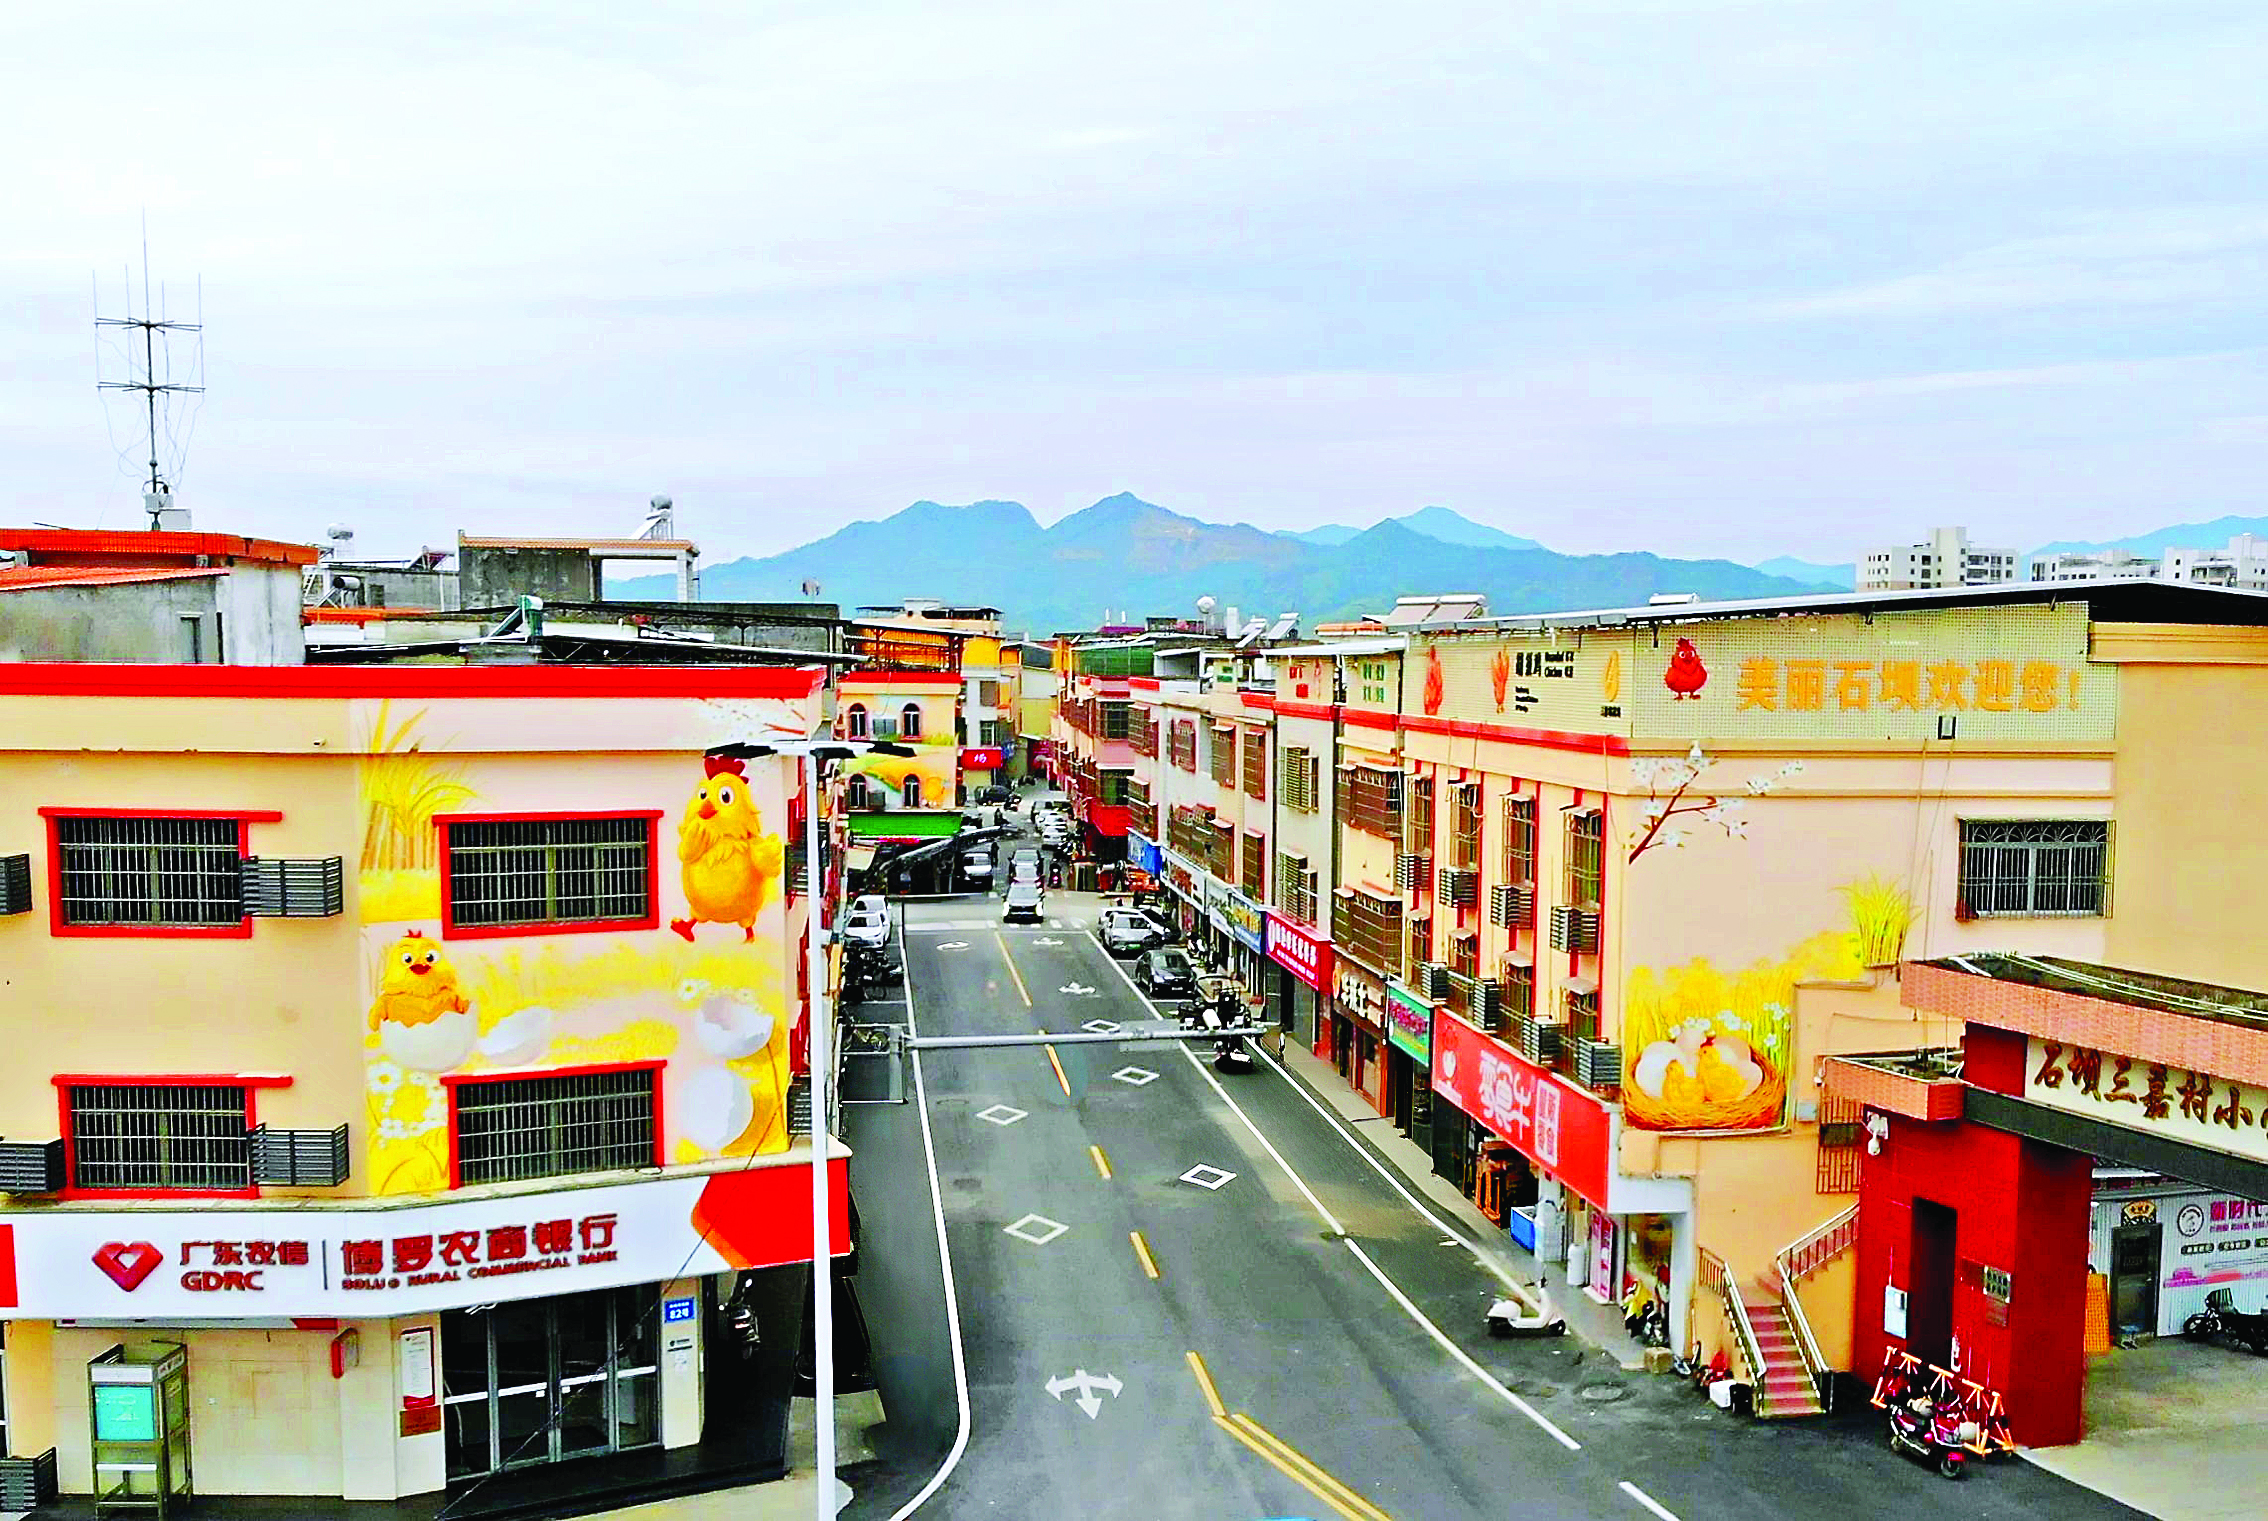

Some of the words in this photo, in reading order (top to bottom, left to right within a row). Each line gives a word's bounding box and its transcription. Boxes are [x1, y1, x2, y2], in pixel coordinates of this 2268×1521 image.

[2033, 1043, 2268, 1137] 石坝三嘉村小
[180, 1239, 309, 1266] 广东农信
[341, 1213, 618, 1276] 博罗农商银行
[180, 1270, 264, 1292] GDRC
[407, 1270, 461, 1288] RURAL
[467, 1256, 571, 1279] COMMERCIAL
[577, 1250, 618, 1266] BANK
